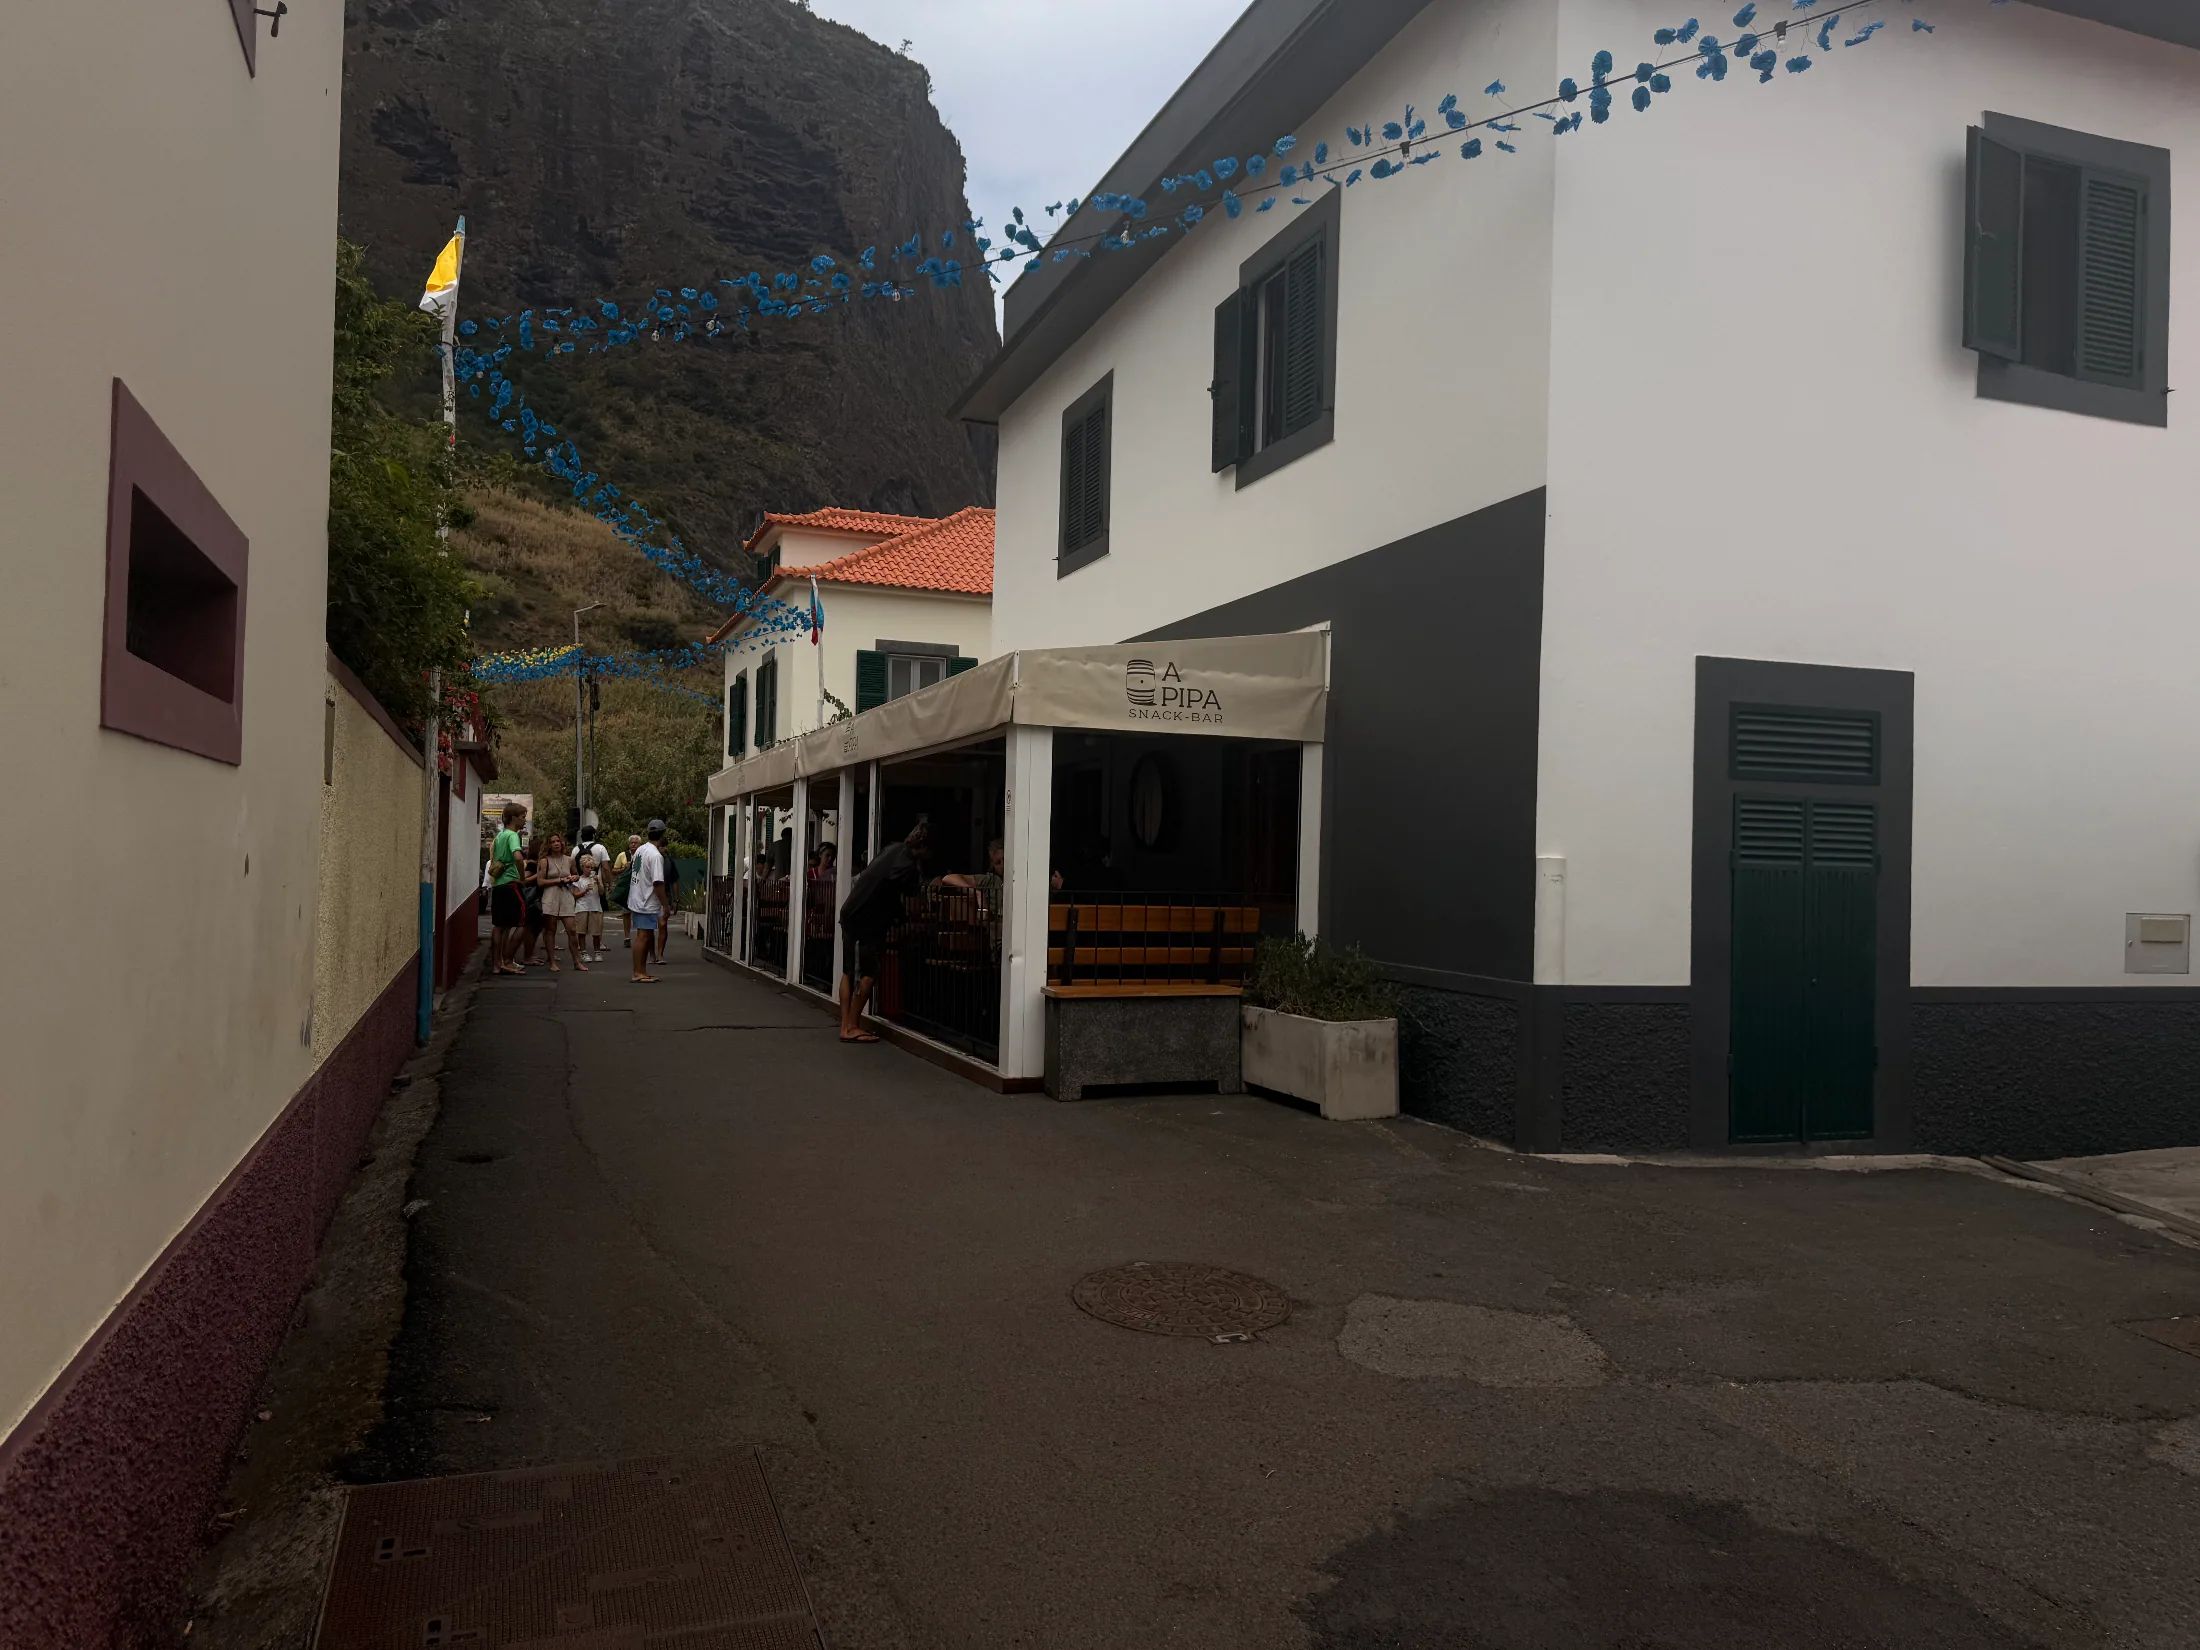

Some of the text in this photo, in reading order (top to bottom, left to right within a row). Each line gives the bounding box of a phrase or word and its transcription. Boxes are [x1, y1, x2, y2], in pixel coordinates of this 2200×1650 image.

[1162, 662, 1181, 682] A
[1162, 687, 1221, 710] PIPA
[1129, 709, 1223, 723] SNACK-BAR
